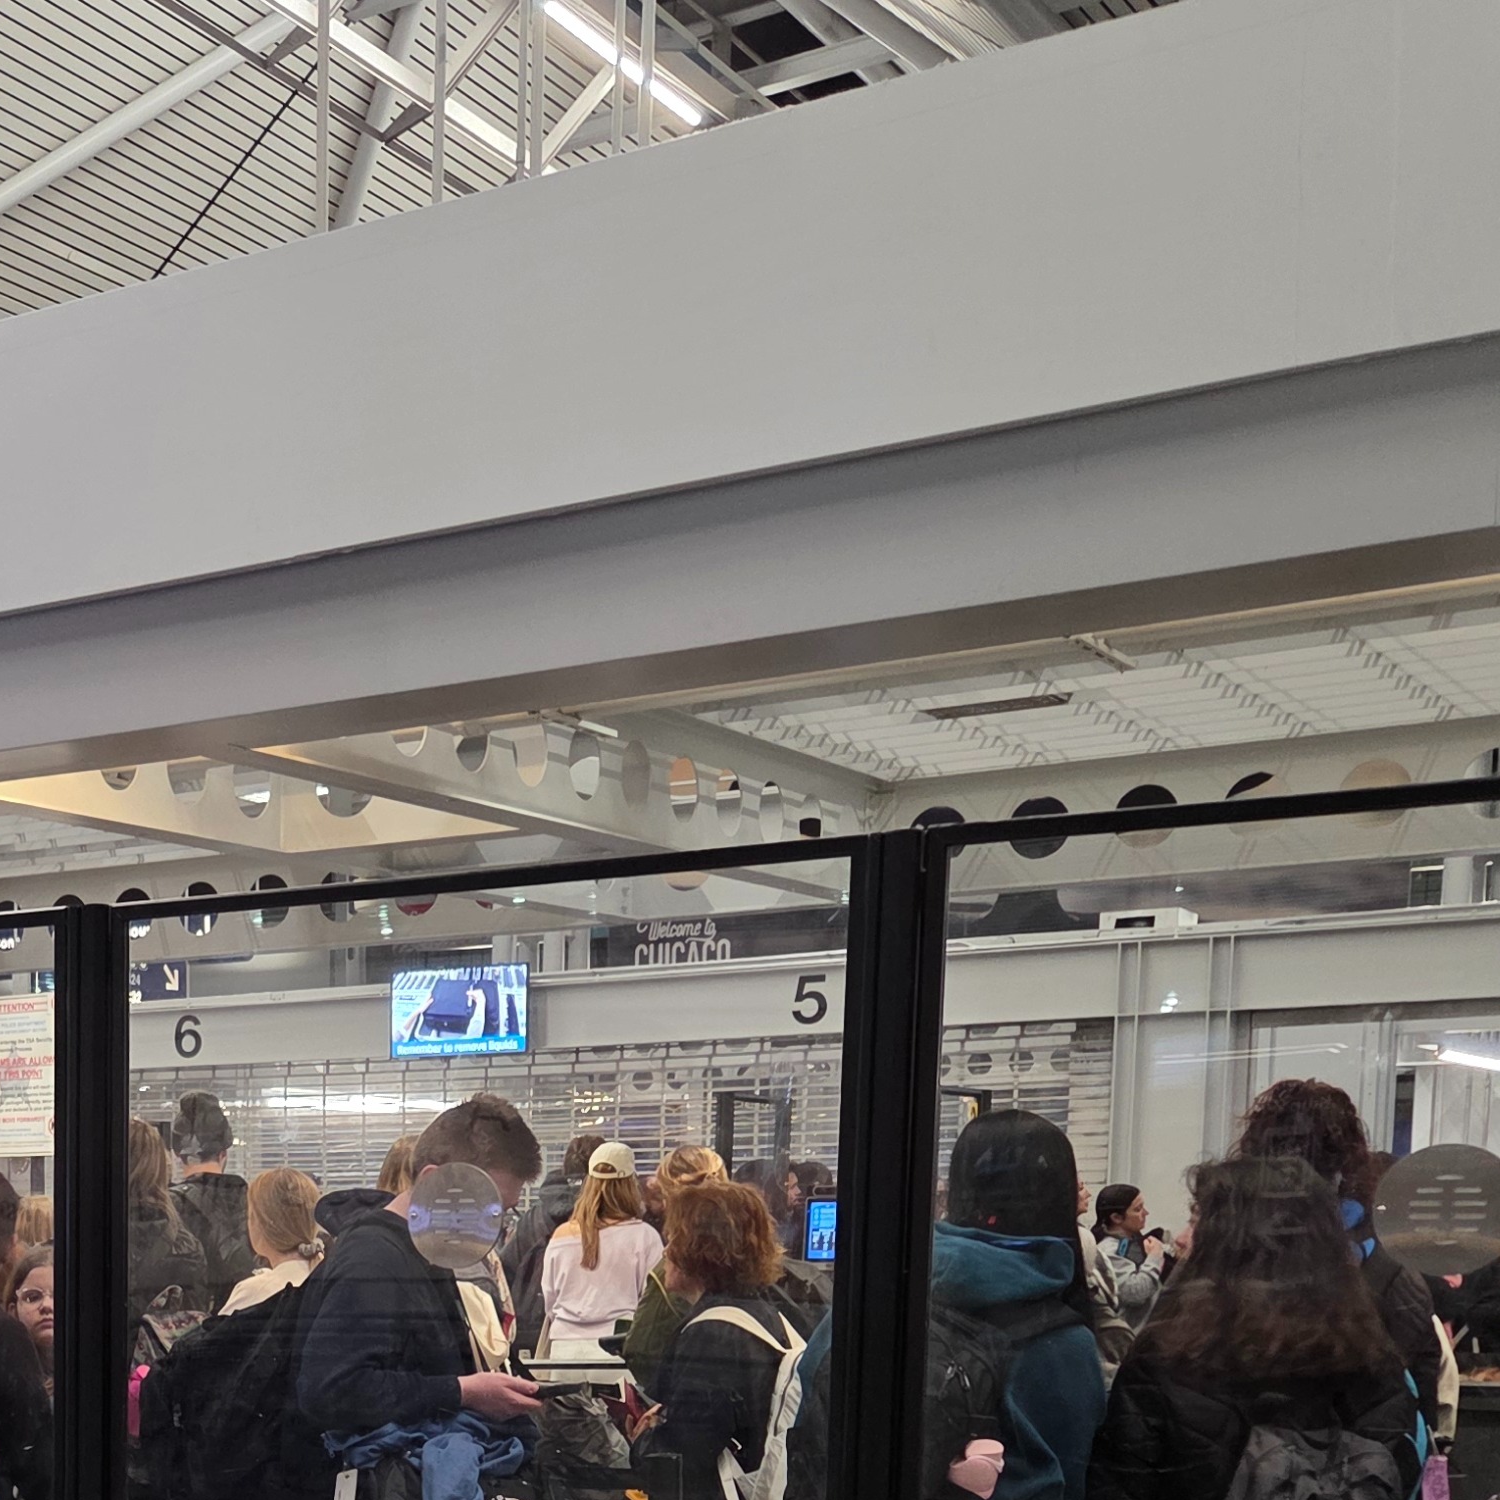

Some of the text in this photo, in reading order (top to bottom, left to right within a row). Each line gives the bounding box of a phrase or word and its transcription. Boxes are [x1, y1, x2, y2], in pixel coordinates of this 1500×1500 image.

[638, 921, 702, 941] Welcome
[792, 973, 828, 1025] 5
[175, 1015, 202, 1058] 6
[396, 1038, 519, 1056] Remember to remove liquids
[30, 1055, 54, 1065] ALLOW
